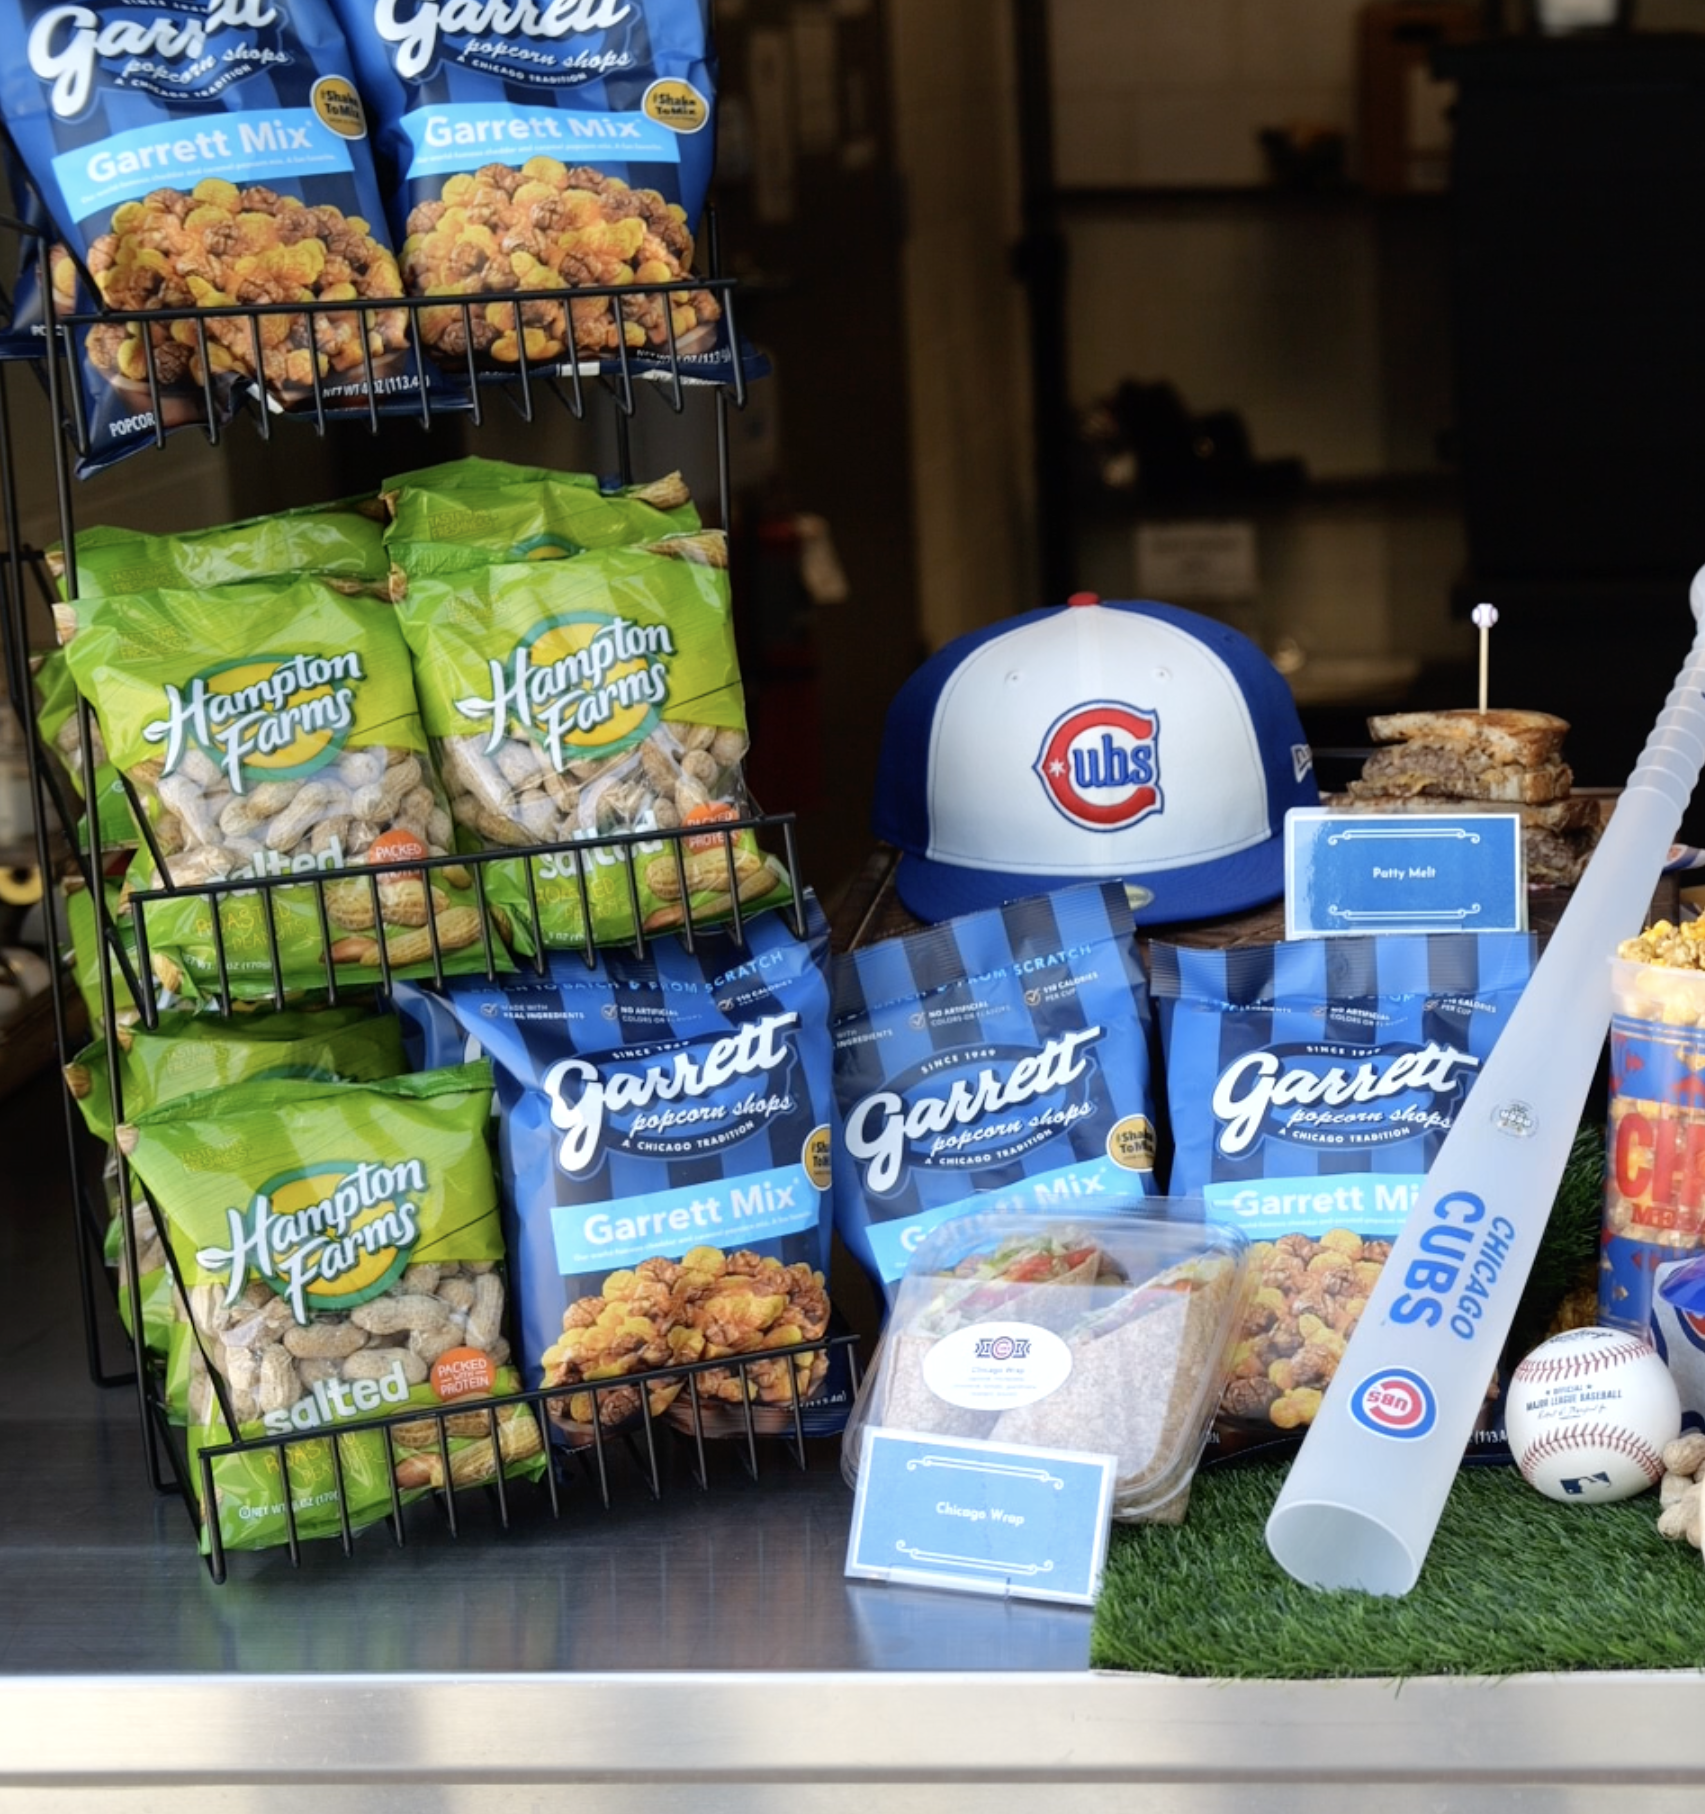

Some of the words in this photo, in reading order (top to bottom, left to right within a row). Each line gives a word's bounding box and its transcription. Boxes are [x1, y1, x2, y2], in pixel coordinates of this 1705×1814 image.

[222, 43, 289, 64] shops
[463, 37, 556, 67] popcorn
[562, 49, 631, 73] shops
[194, 65, 253, 98] TRADITION
[472, 59, 525, 80] CHICAGO
[528, 71, 588, 85] TRADITION
[424, 115, 562, 147] Garrett
[568, 117, 641, 139] Mix
[86, 129, 231, 183] Garrett
[239, 120, 313, 152] Mix
[384, 375, 431, 394] (113.4)
[109, 412, 156, 437] POPCOR
[455, 617, 673, 755] Hampton
[144, 652, 362, 778] Hampton
[538, 661, 666, 772] Farms
[217, 687, 351, 794] Farms
[375, 843, 422, 860] PACKED
[1372, 867, 1406, 882] Patty
[1408, 866, 1436, 880] Melt
[705, 951, 783, 994] SCRATCH
[1014, 944, 1093, 977] SCRATCH
[1057, 971, 1099, 991] CALORIES
[928, 1008, 943, 1019] NO
[612, 1047, 651, 1061] SINCE
[921, 1054, 960, 1075] SINCE
[544, 1011, 798, 1172] Garrett
[1213, 1041, 1479, 1153] Garrett
[629, 1105, 727, 1138] popcorn
[732, 1092, 792, 1120] shops
[845, 1026, 1101, 1192] Garrett
[1287, 1109, 1383, 1128] popcorn
[1389, 1104, 1453, 1129] shops
[621, 1139, 631, 1148] A
[637, 1141, 692, 1153] CHICAGO
[696, 1120, 756, 1149] TRADITION
[931, 1120, 1023, 1157] popcorn
[1027, 1099, 1093, 1127] shops
[1292, 1130, 1345, 1144] CHICAGO
[1350, 1126, 1411, 1143] TRADITION
[939, 1153, 992, 1166] CHICAGO
[997, 1128, 1054, 1160] TRADITION
[1033, 1167, 1106, 1207] Mix
[1233, 1186, 1365, 1217] Garrett
[1375, 1183, 1419, 1213] Mi
[583, 1195, 722, 1247] Garrett
[730, 1181, 796, 1219] Mix
[197, 1159, 426, 1307] Hampton
[283, 1202, 416, 1325] Farms
[1388, 1190, 1486, 1329] CUBS
[1450, 1216, 1516, 1341] CHICAGO
[437, 1358, 487, 1376] PACKED
[263, 1361, 409, 1435] salted
[440, 1377, 489, 1396] PROTEIN
[1526, 1397, 1549, 1411] MAJOR
[1551, 1393, 1578, 1405] LEAGUE
[1579, 1389, 1622, 1402] BASEBALL
[935, 1500, 986, 1521] Chicago
[990, 1506, 1026, 1527] Wrap
